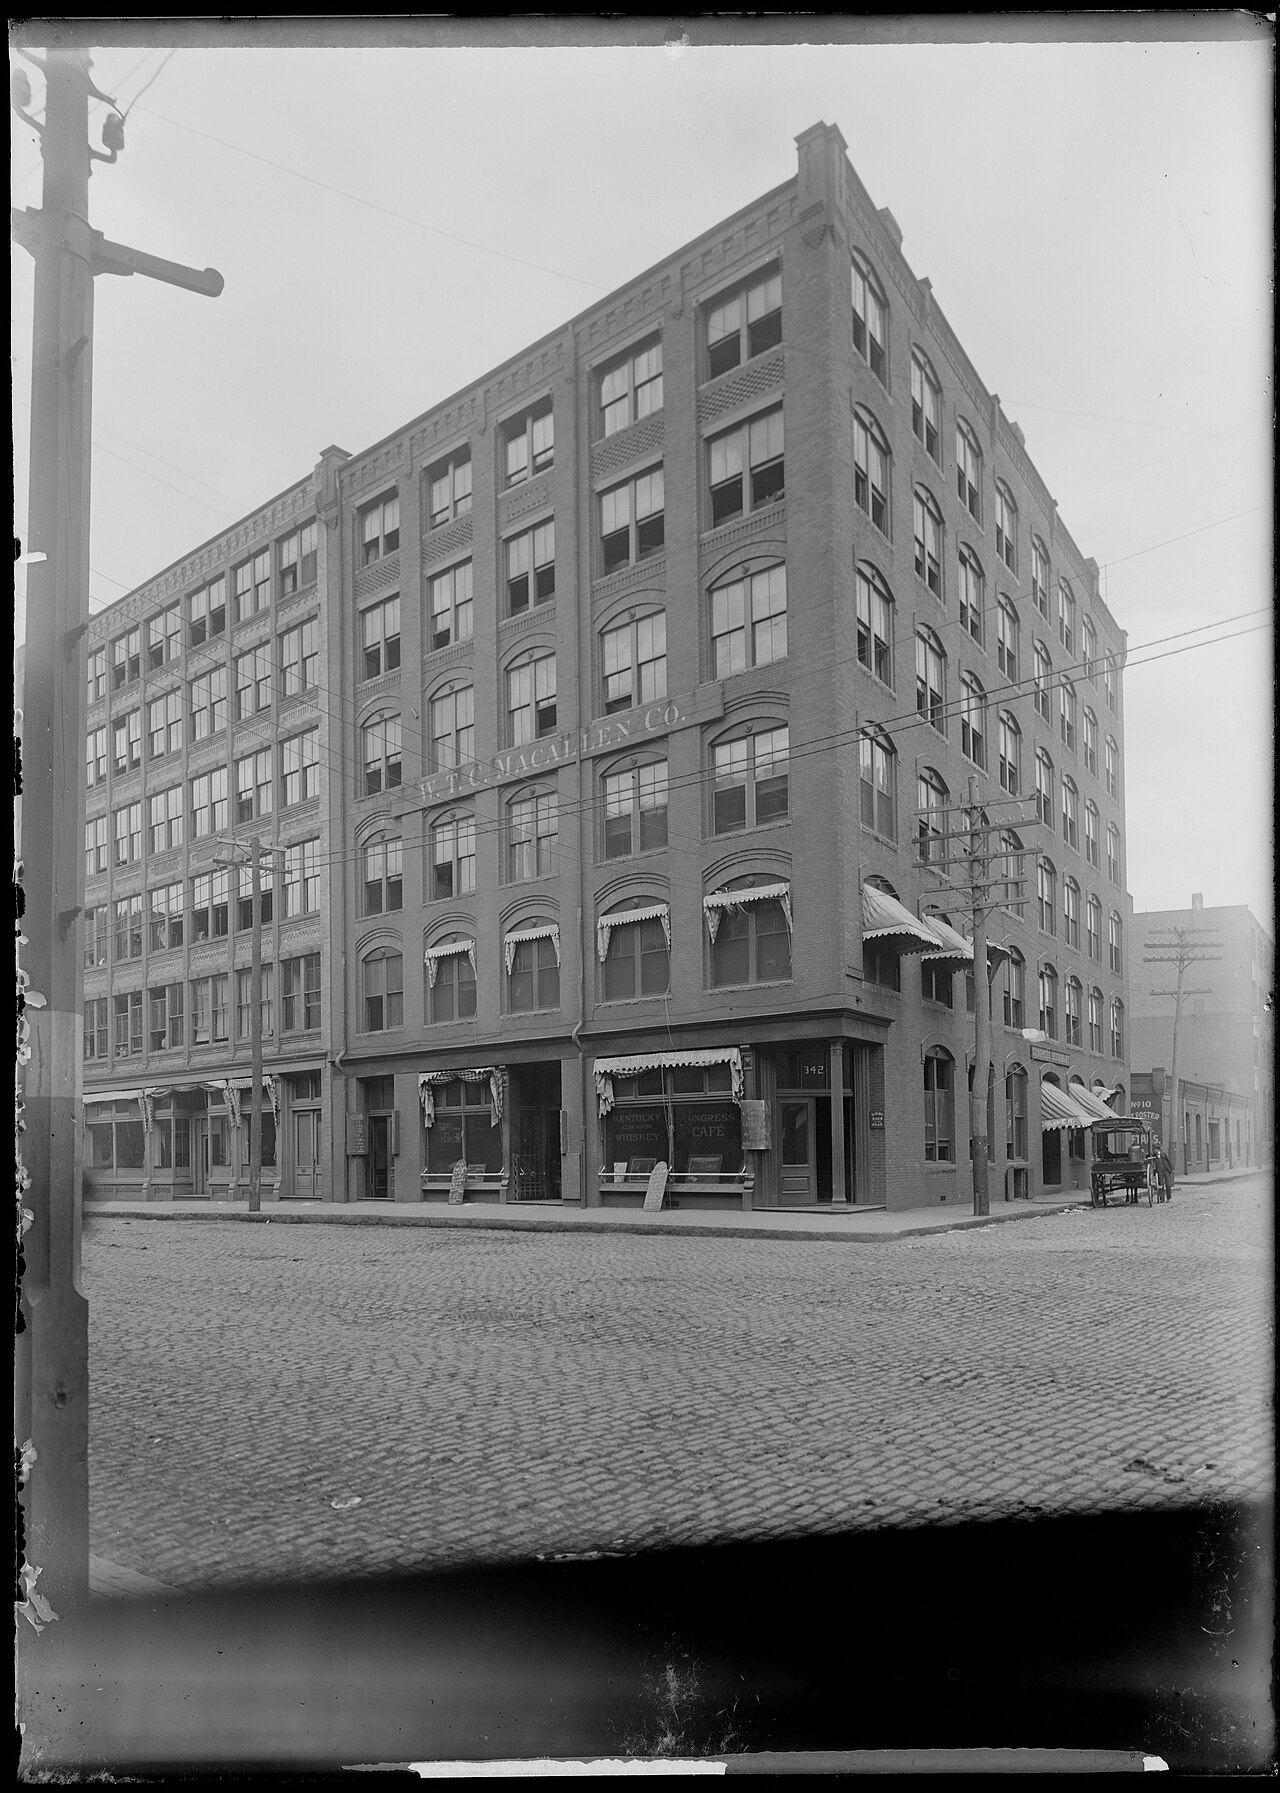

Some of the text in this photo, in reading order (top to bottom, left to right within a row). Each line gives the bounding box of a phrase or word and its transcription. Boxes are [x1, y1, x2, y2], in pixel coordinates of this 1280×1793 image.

[496, 720, 631, 780] MACALLEN
[645, 704, 686, 731] CO.
[804, 1065, 824, 1074] 342
[613, 1112, 661, 1122] KENTUCKY
[615, 1133, 660, 1141] WHISKEY
